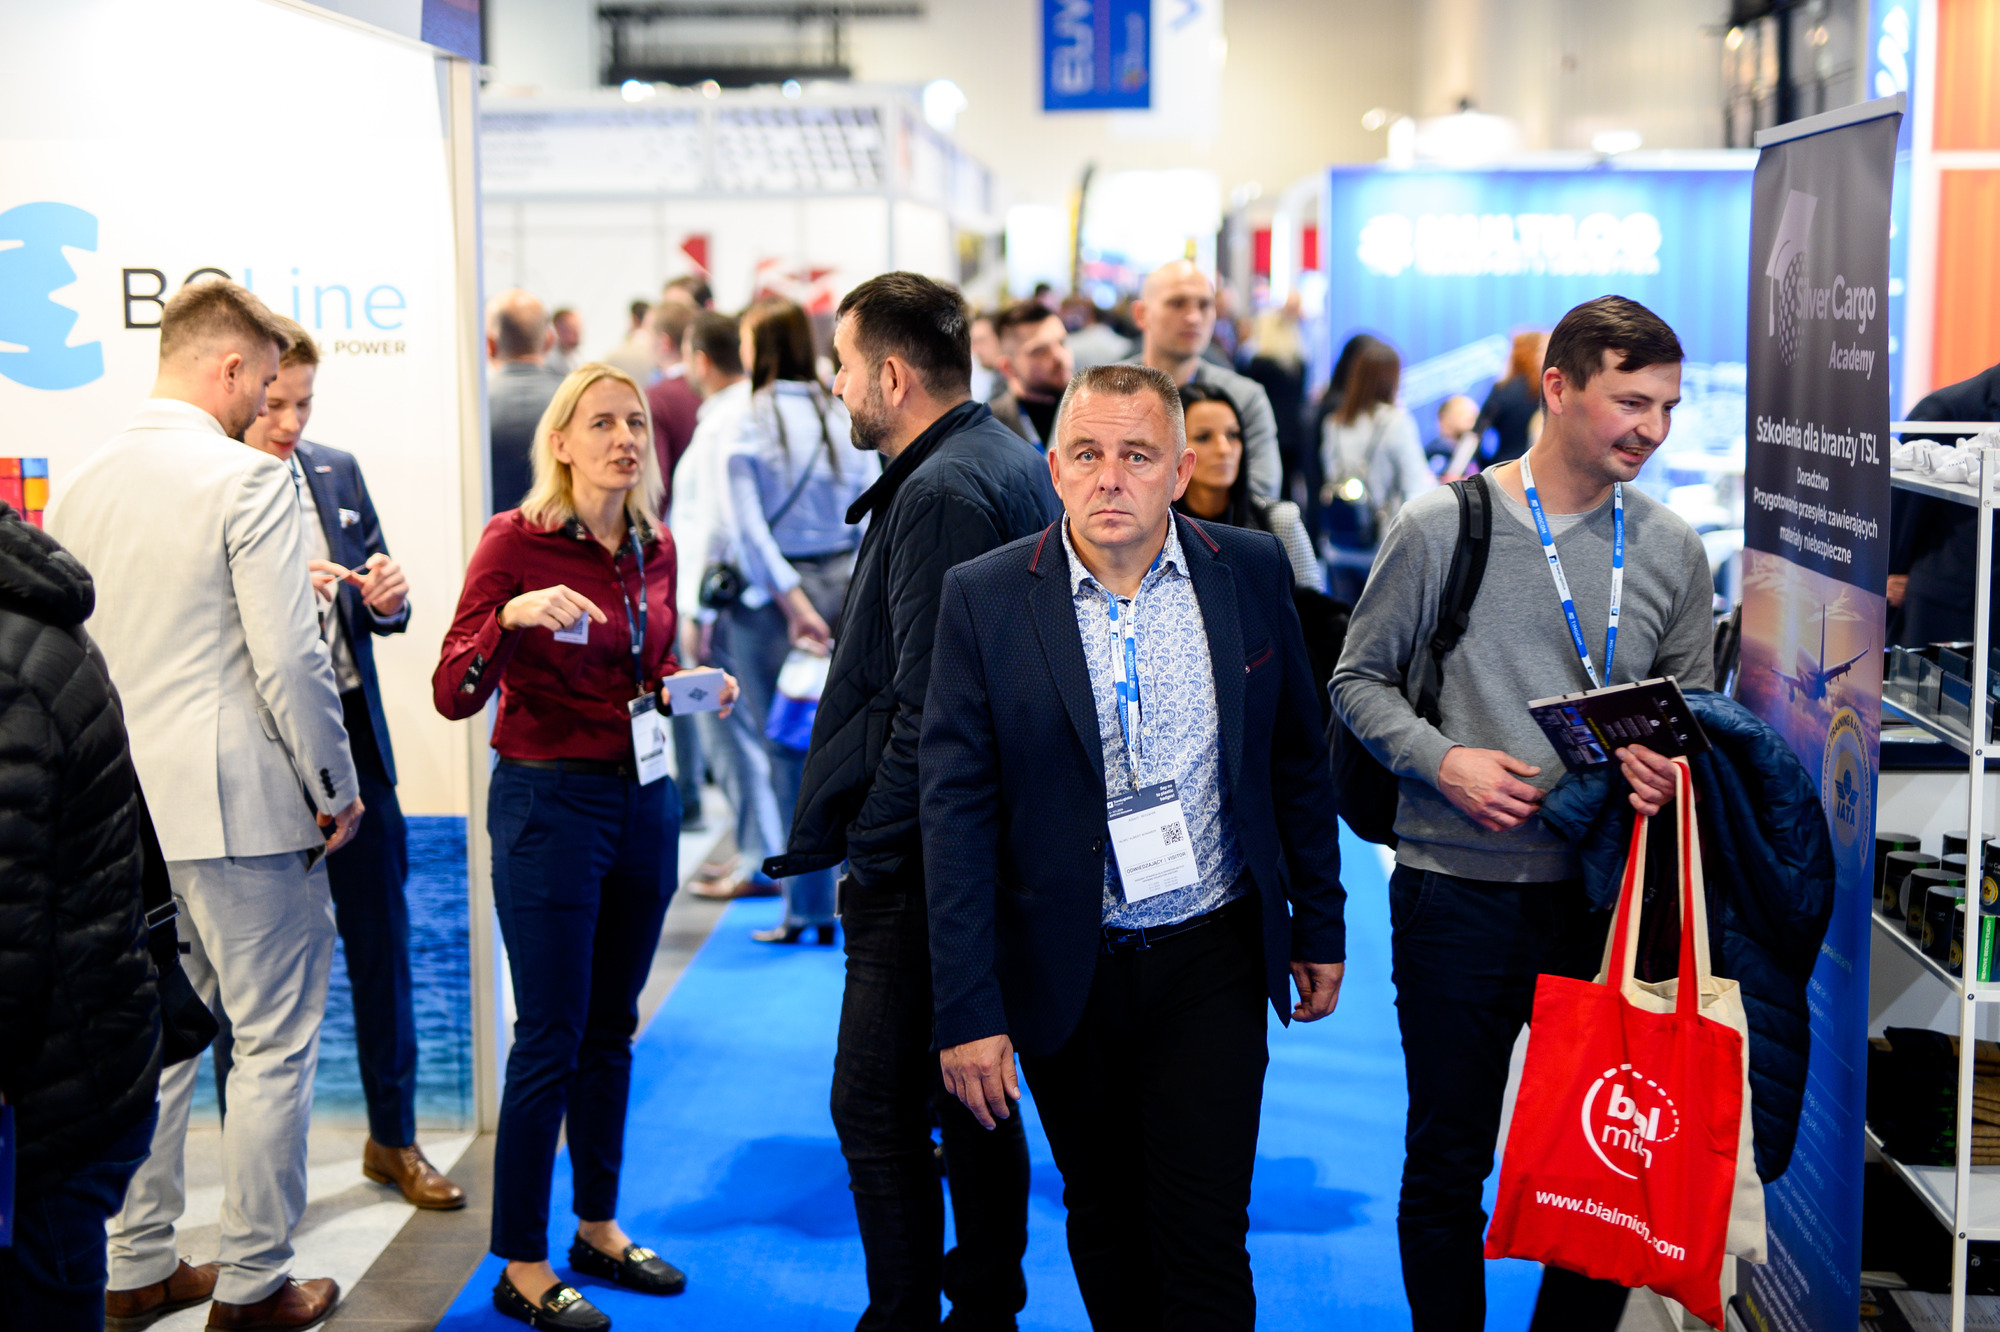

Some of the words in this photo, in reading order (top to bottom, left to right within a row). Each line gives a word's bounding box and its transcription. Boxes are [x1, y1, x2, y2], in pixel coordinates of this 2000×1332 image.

[122, 267, 407, 330] Bine
[1796, 277, 1830, 320] Silver
[1832, 274, 1877, 335] Cargo
[335, 340, 407, 355] POWER
[1829, 340, 1876, 380] Academy
[1756, 415, 1802, 449] Szkolenia
[1804, 422, 1819, 453] dla
[1821, 424, 1858, 467] branży
[1860, 432, 1880, 465] TSL
[1797, 466, 1829, 491] Doradztwo
[1534, 507, 1548, 534] TIMOCOM
[1754, 486, 1798, 515] Przygotowanie
[1828, 509, 1878, 541] zawierających
[1804, 531, 1852, 564] niebezpieczne
[1571, 620, 1583, 646] TIMOCOM
[1837, 802, 1856, 827] IATA
[1126, 859, 1163, 874] ODWIEDZAJĄCY
[1167, 851, 1186, 861] VISITOR
[1607, 1083, 1661, 1141] bal
[1535, 1190, 1686, 1261] www.bialmich.com
